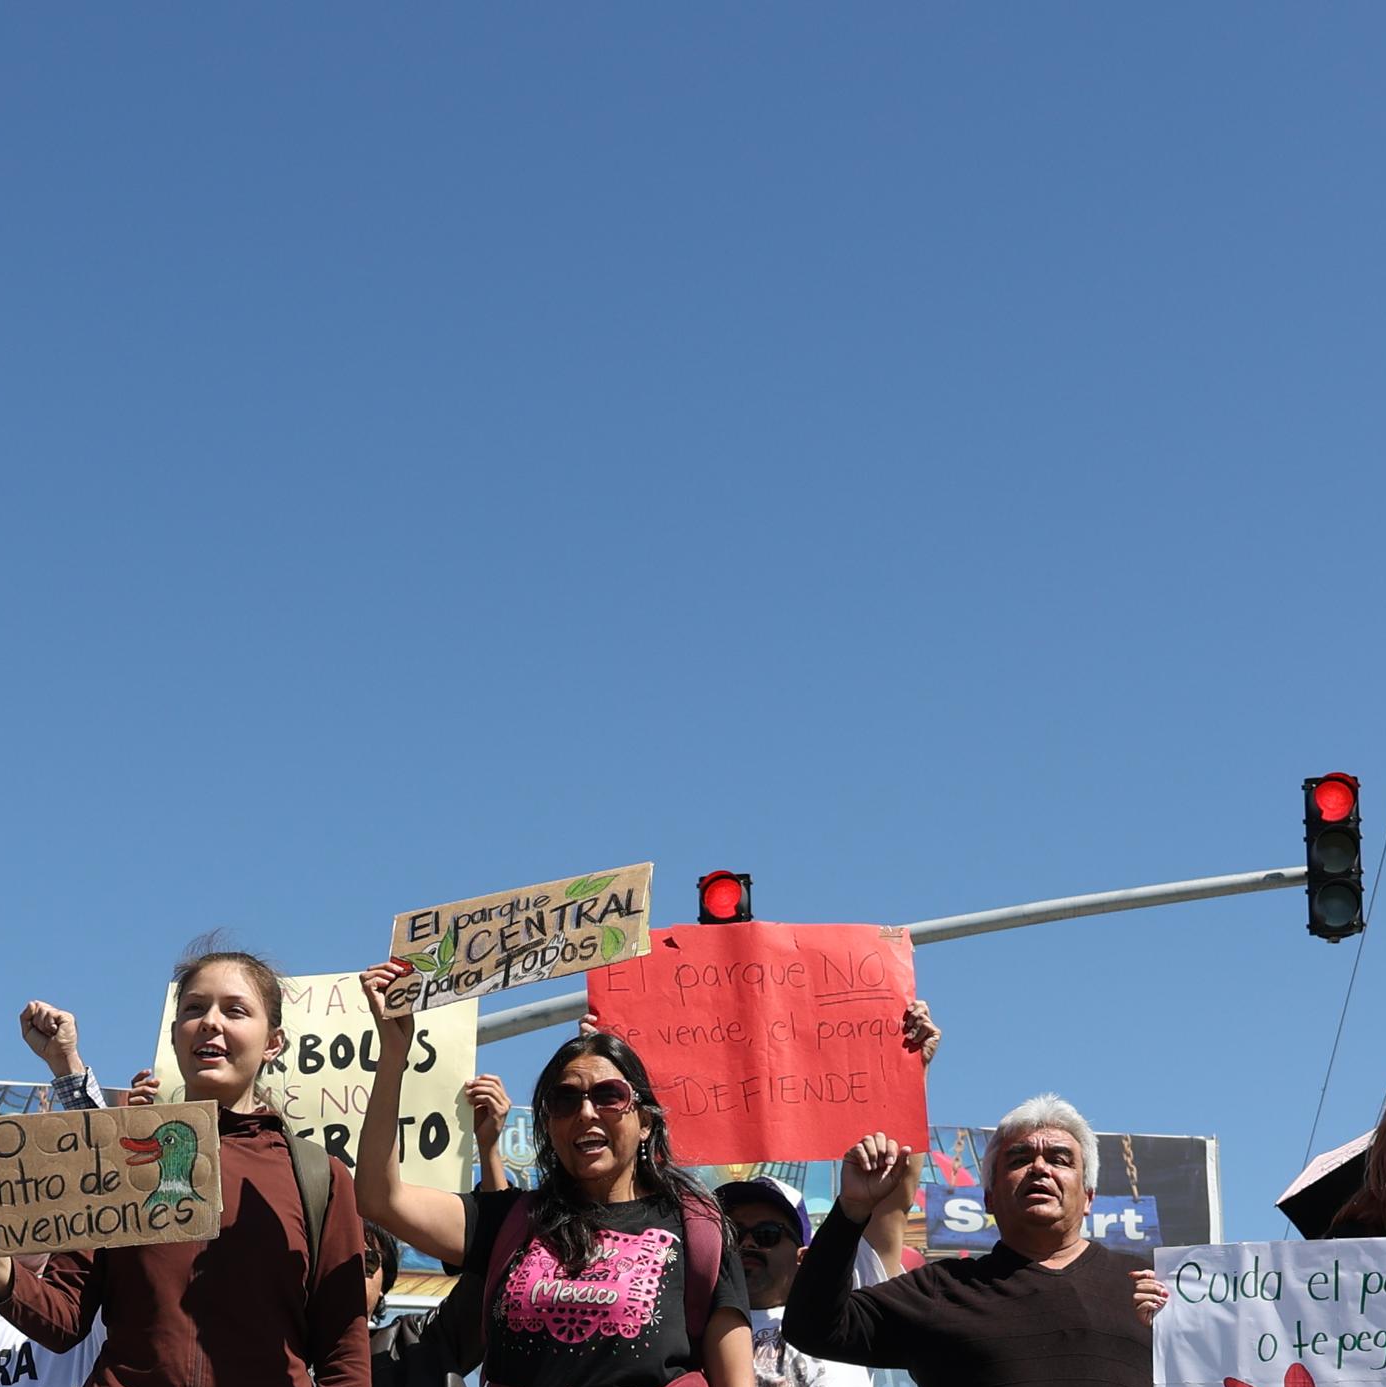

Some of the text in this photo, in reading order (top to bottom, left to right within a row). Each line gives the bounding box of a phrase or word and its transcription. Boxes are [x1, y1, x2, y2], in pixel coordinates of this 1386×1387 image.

[409, 893, 551, 947] El parque
[466, 888, 644, 964] CENTRAL
[422, 967, 484, 1010] para
[495, 935, 598, 988] TODOS
[608, 951, 886, 1007] El parque NO
[657, 1016, 754, 1047] vende,
[817, 1017, 904, 1050] parqu
[57, 1111, 99, 1152] al
[80, 1143, 121, 1196] de
[531, 1279, 619, 1305] México
[1175, 1256, 1283, 1304] Cuida
[1307, 1260, 1340, 1302] el
[1257, 1330, 1278, 1362] o
[1293, 1320, 1329, 1360] te
